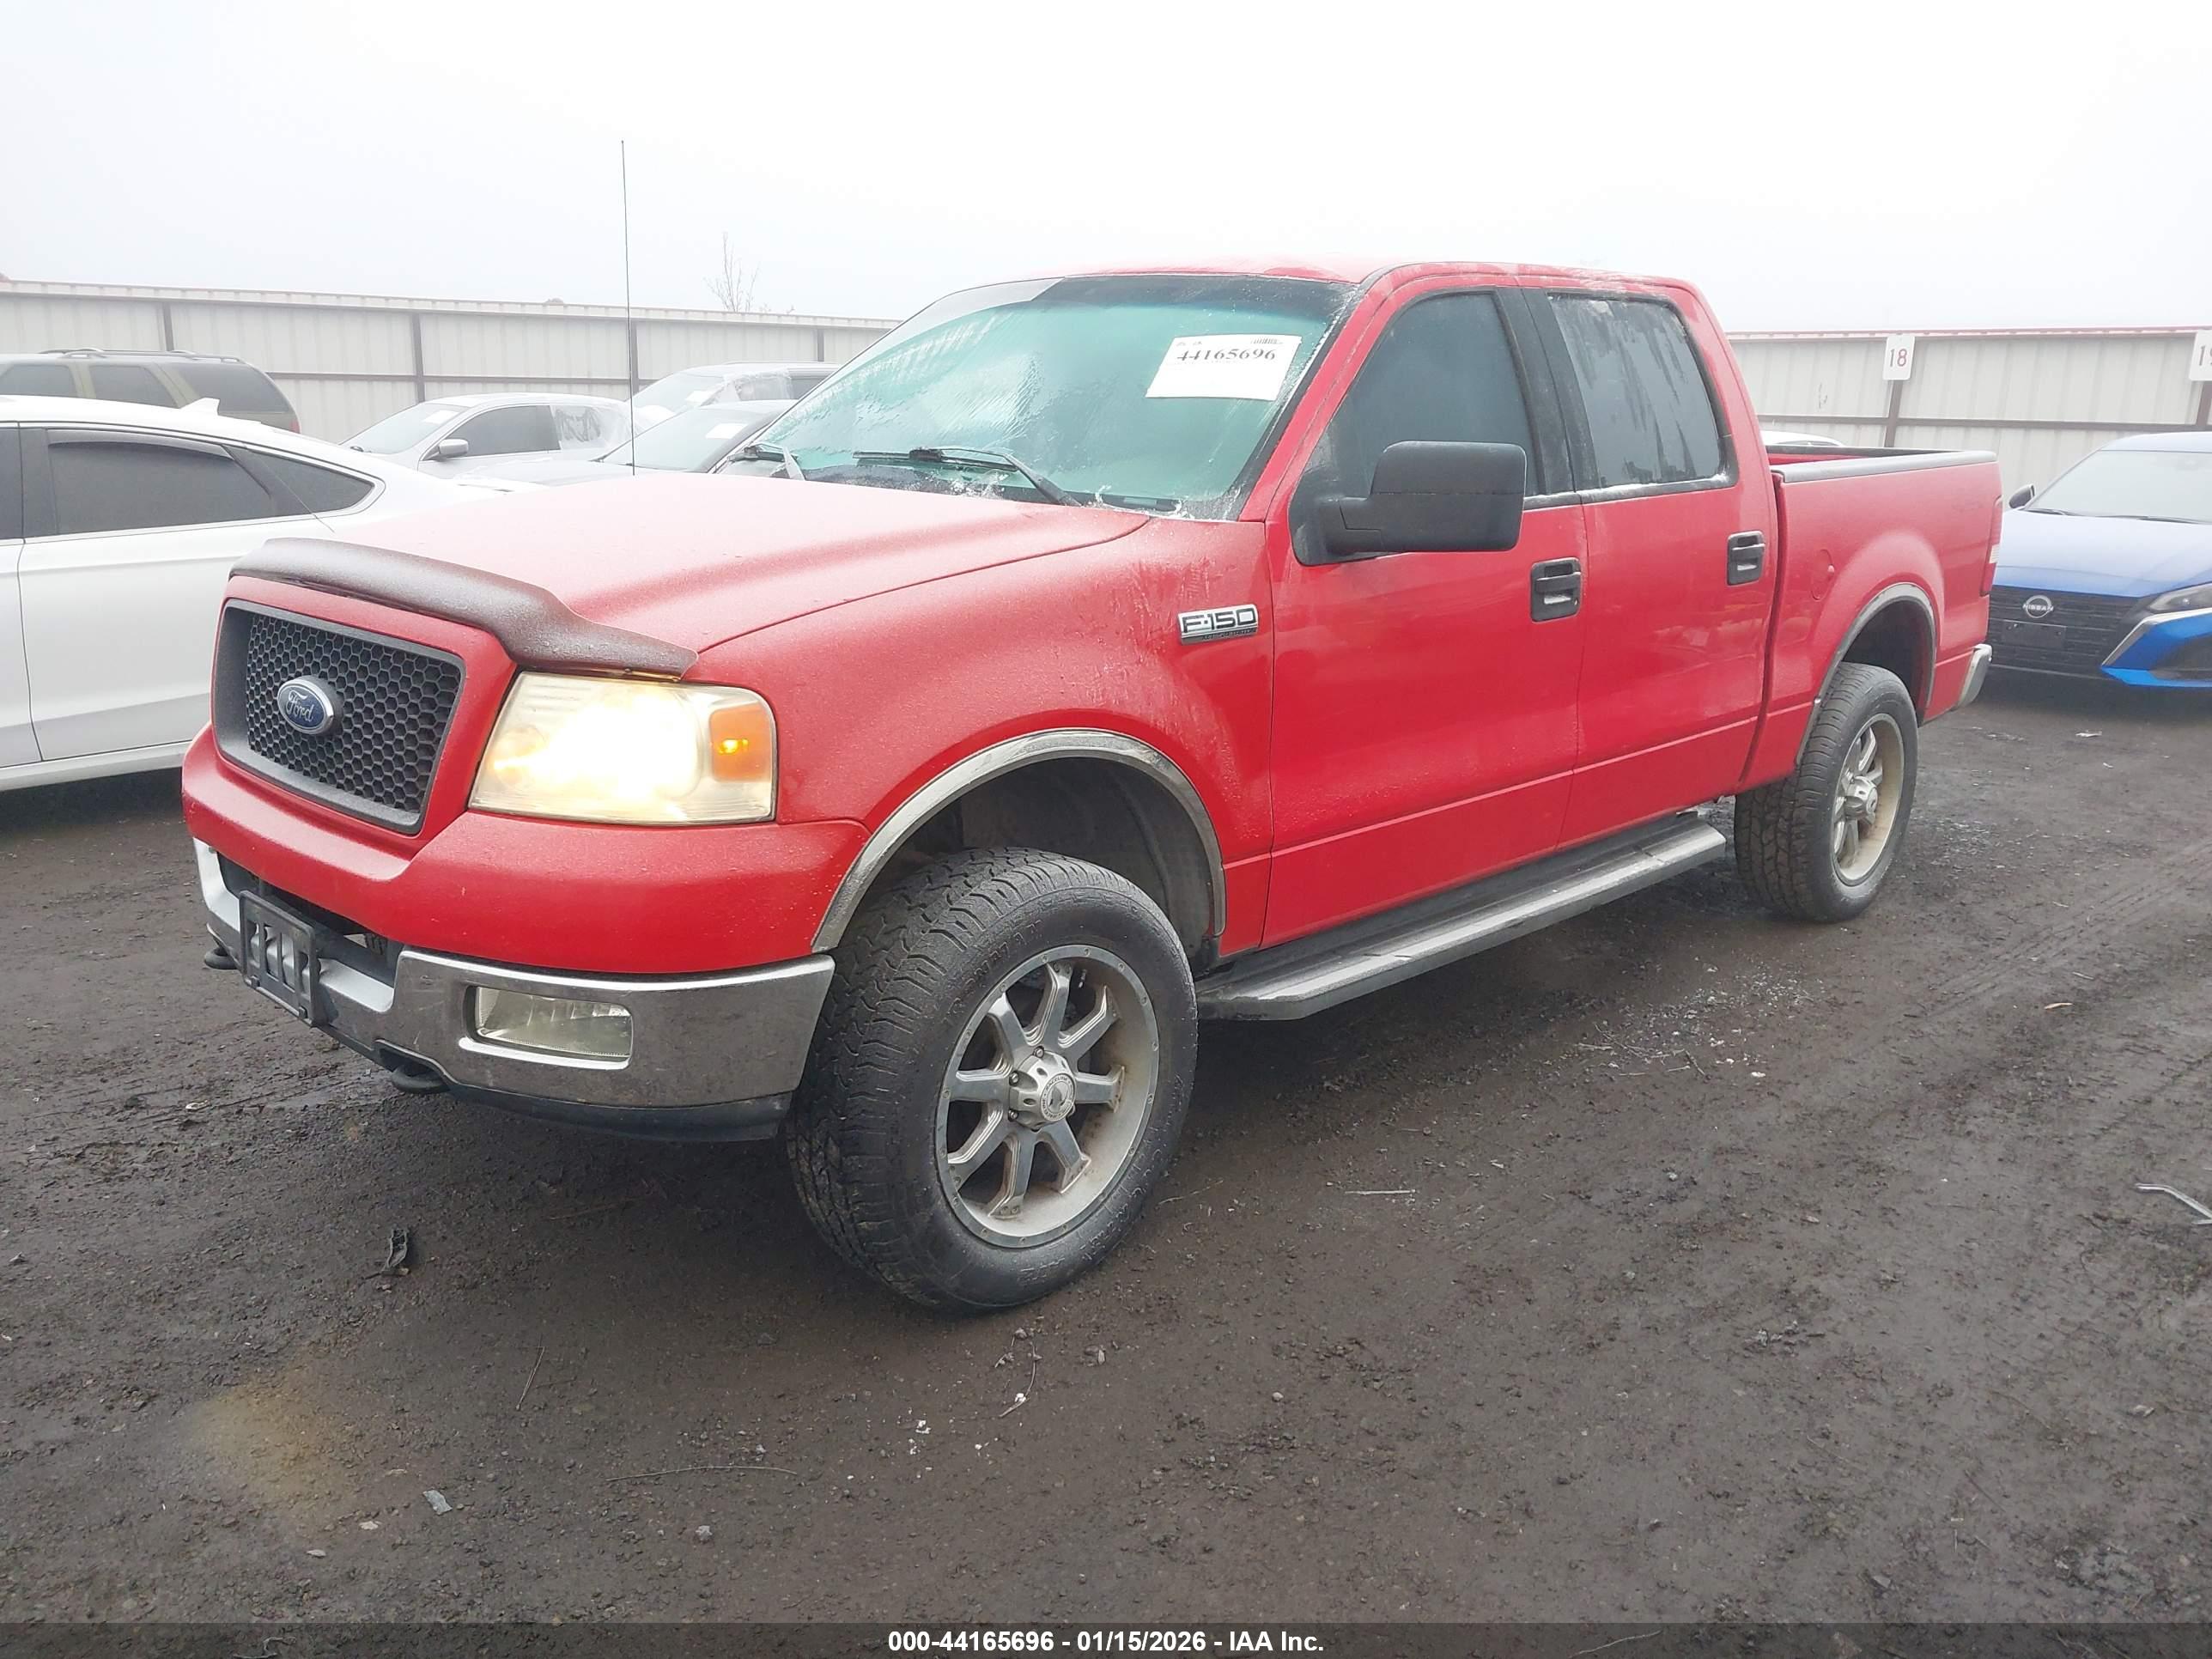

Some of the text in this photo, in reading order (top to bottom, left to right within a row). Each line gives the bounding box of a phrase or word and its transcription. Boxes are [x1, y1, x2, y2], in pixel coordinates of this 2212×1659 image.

[1176, 349, 1276, 362] 44165696
[1890, 349, 1907, 368] 18
[285, 690, 315, 723] Ford
